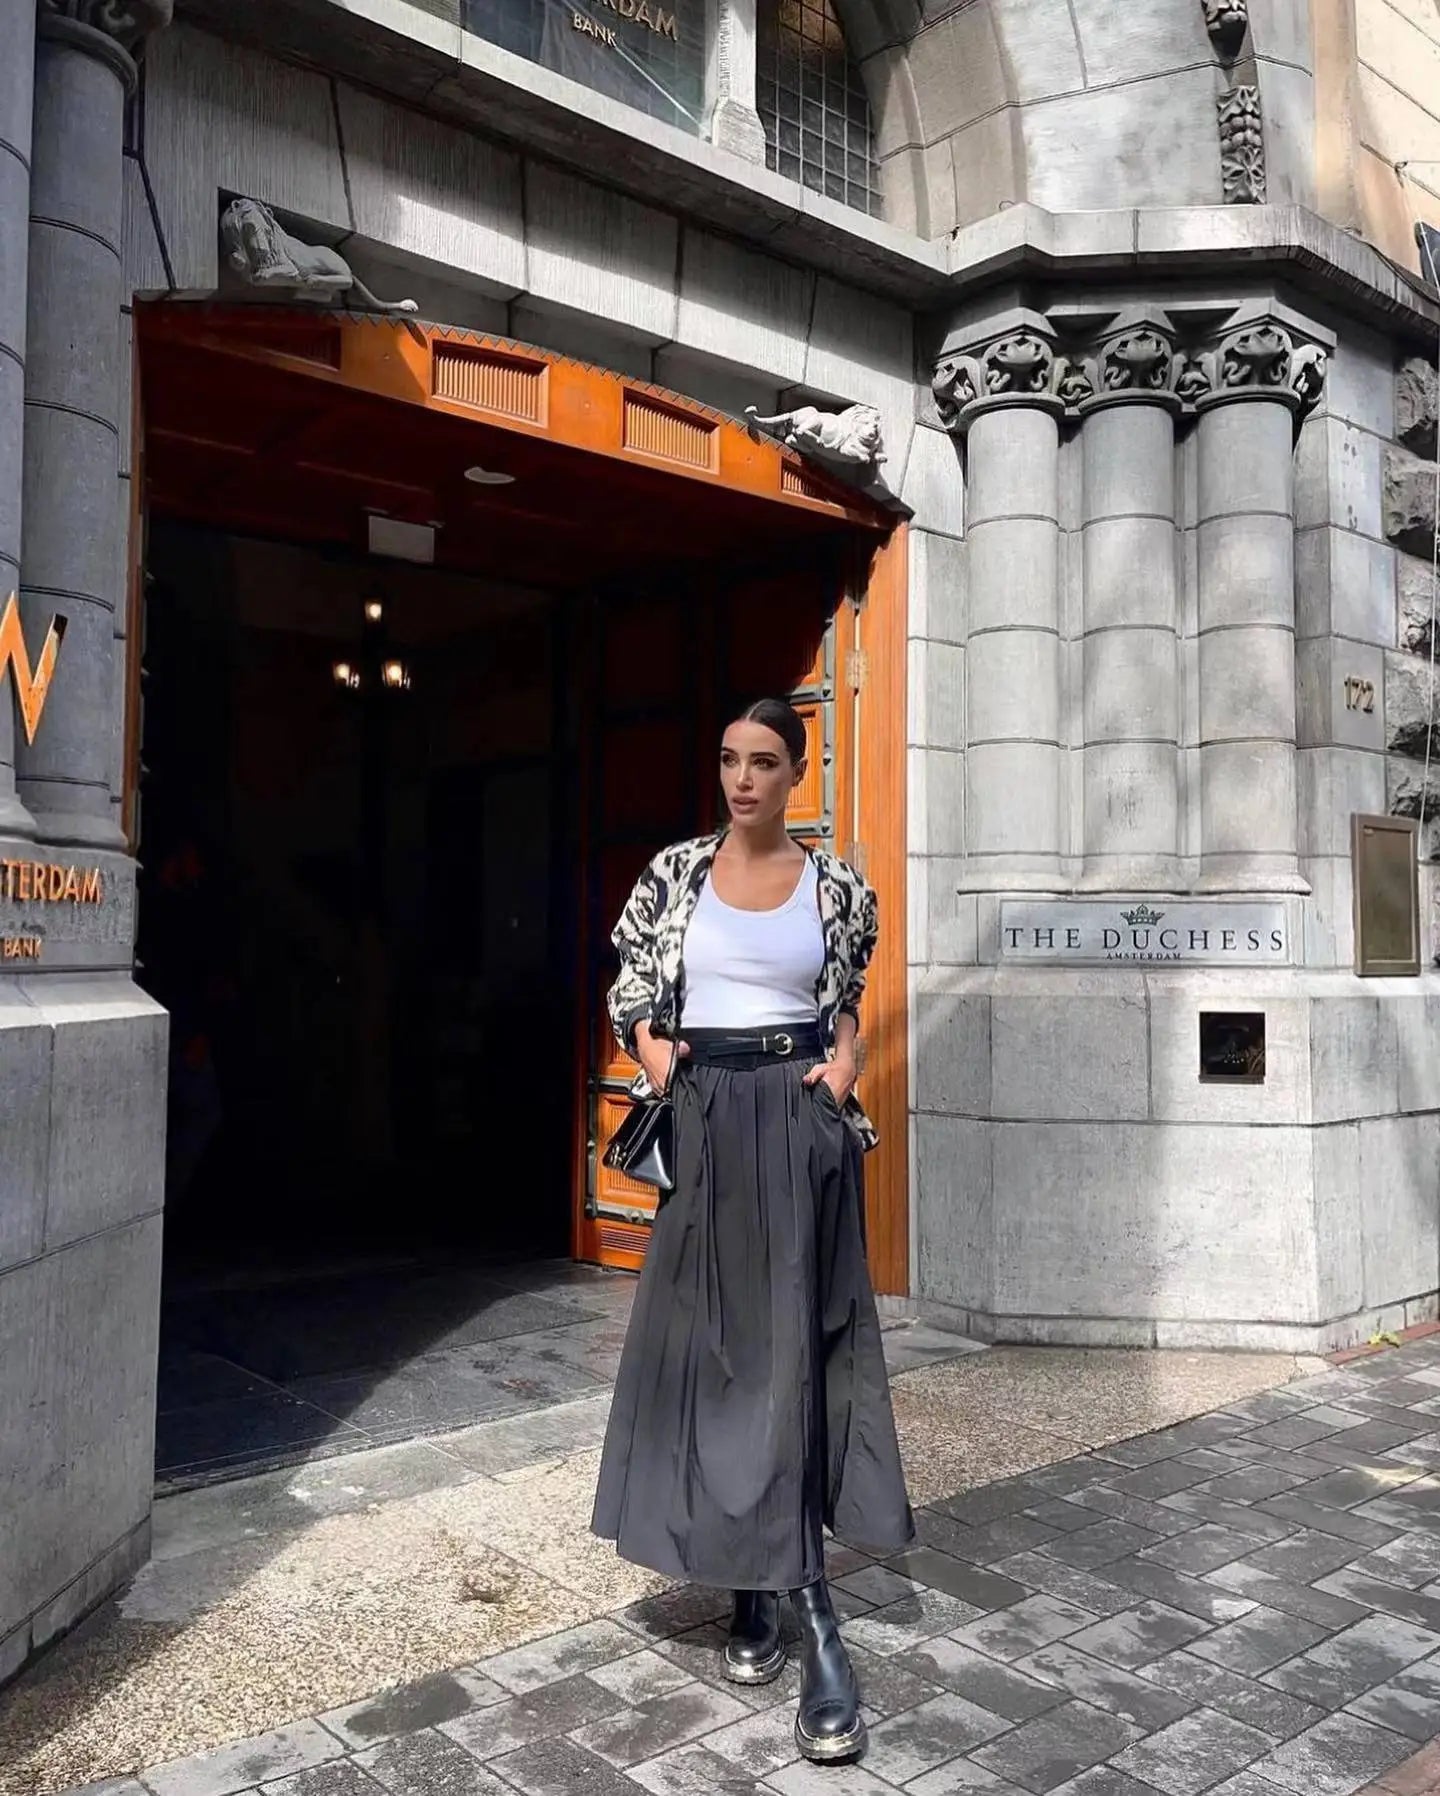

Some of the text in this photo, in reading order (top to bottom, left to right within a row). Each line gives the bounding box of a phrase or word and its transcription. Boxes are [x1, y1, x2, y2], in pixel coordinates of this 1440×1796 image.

[573, 12, 617, 47] BANK
[1343, 674, 1375, 714] 172
[4, 935, 42, 958] BANK
[1004, 927, 1283, 951] THE DUCHESS
[1106, 952, 1181, 960] AMSTERDAM
